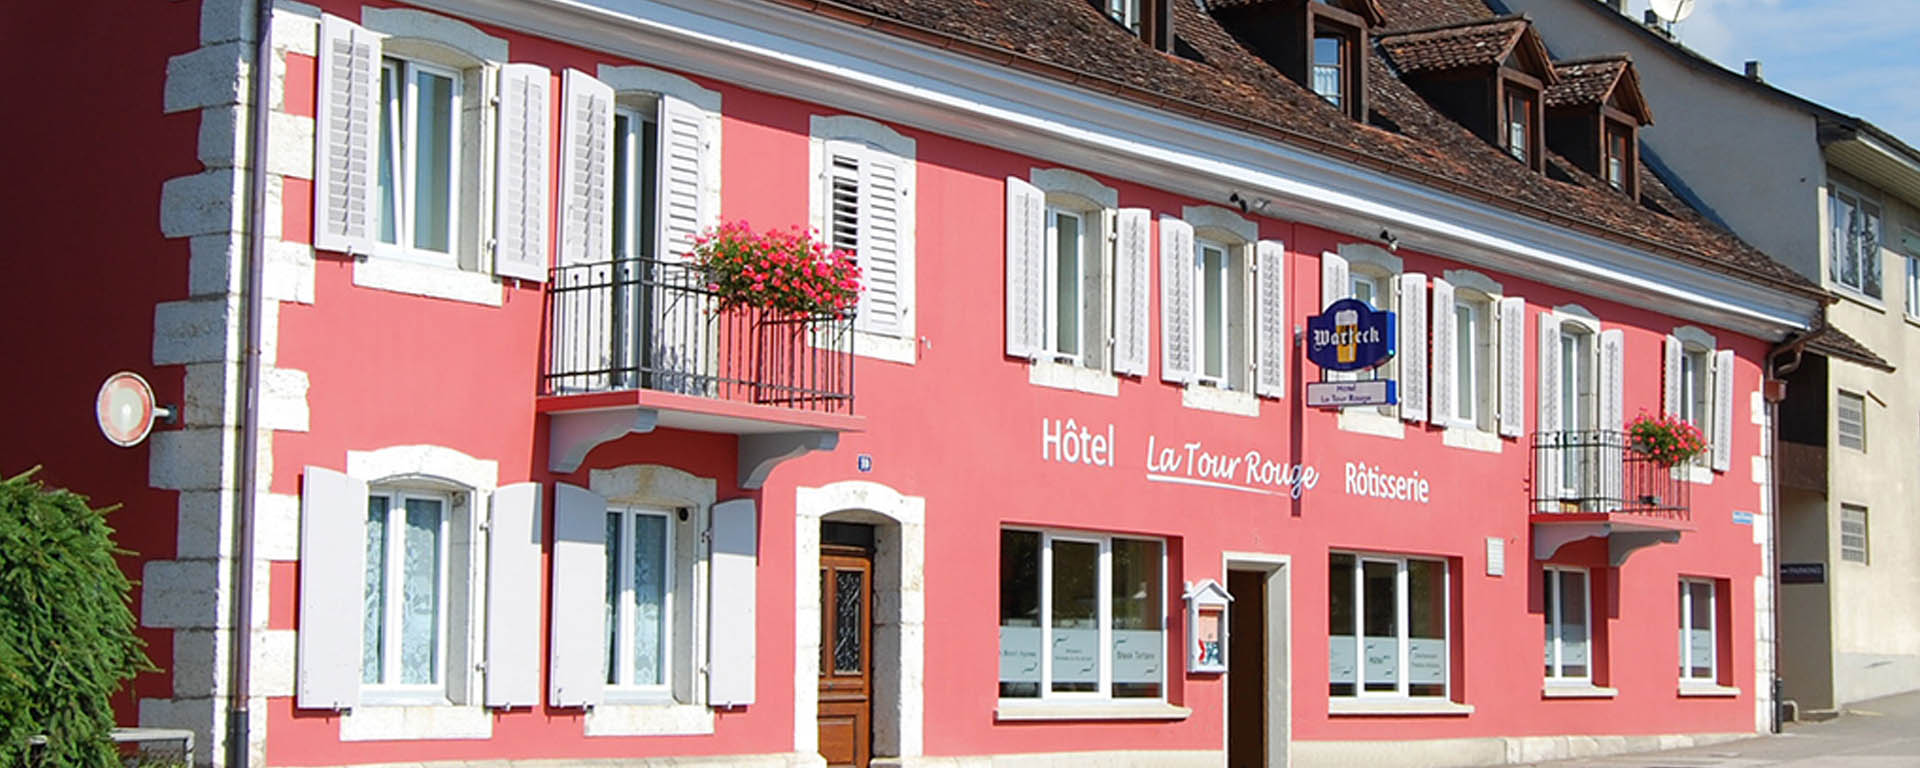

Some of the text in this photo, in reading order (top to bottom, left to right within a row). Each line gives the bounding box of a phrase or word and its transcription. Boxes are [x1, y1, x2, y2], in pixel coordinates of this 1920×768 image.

[1313, 326, 1380, 352] Warteck
[1042, 418, 1114, 467] Hôtel
[1146, 435, 1319, 499] La Tour Rouge
[1345, 462, 1430, 503] Rôtisserie
